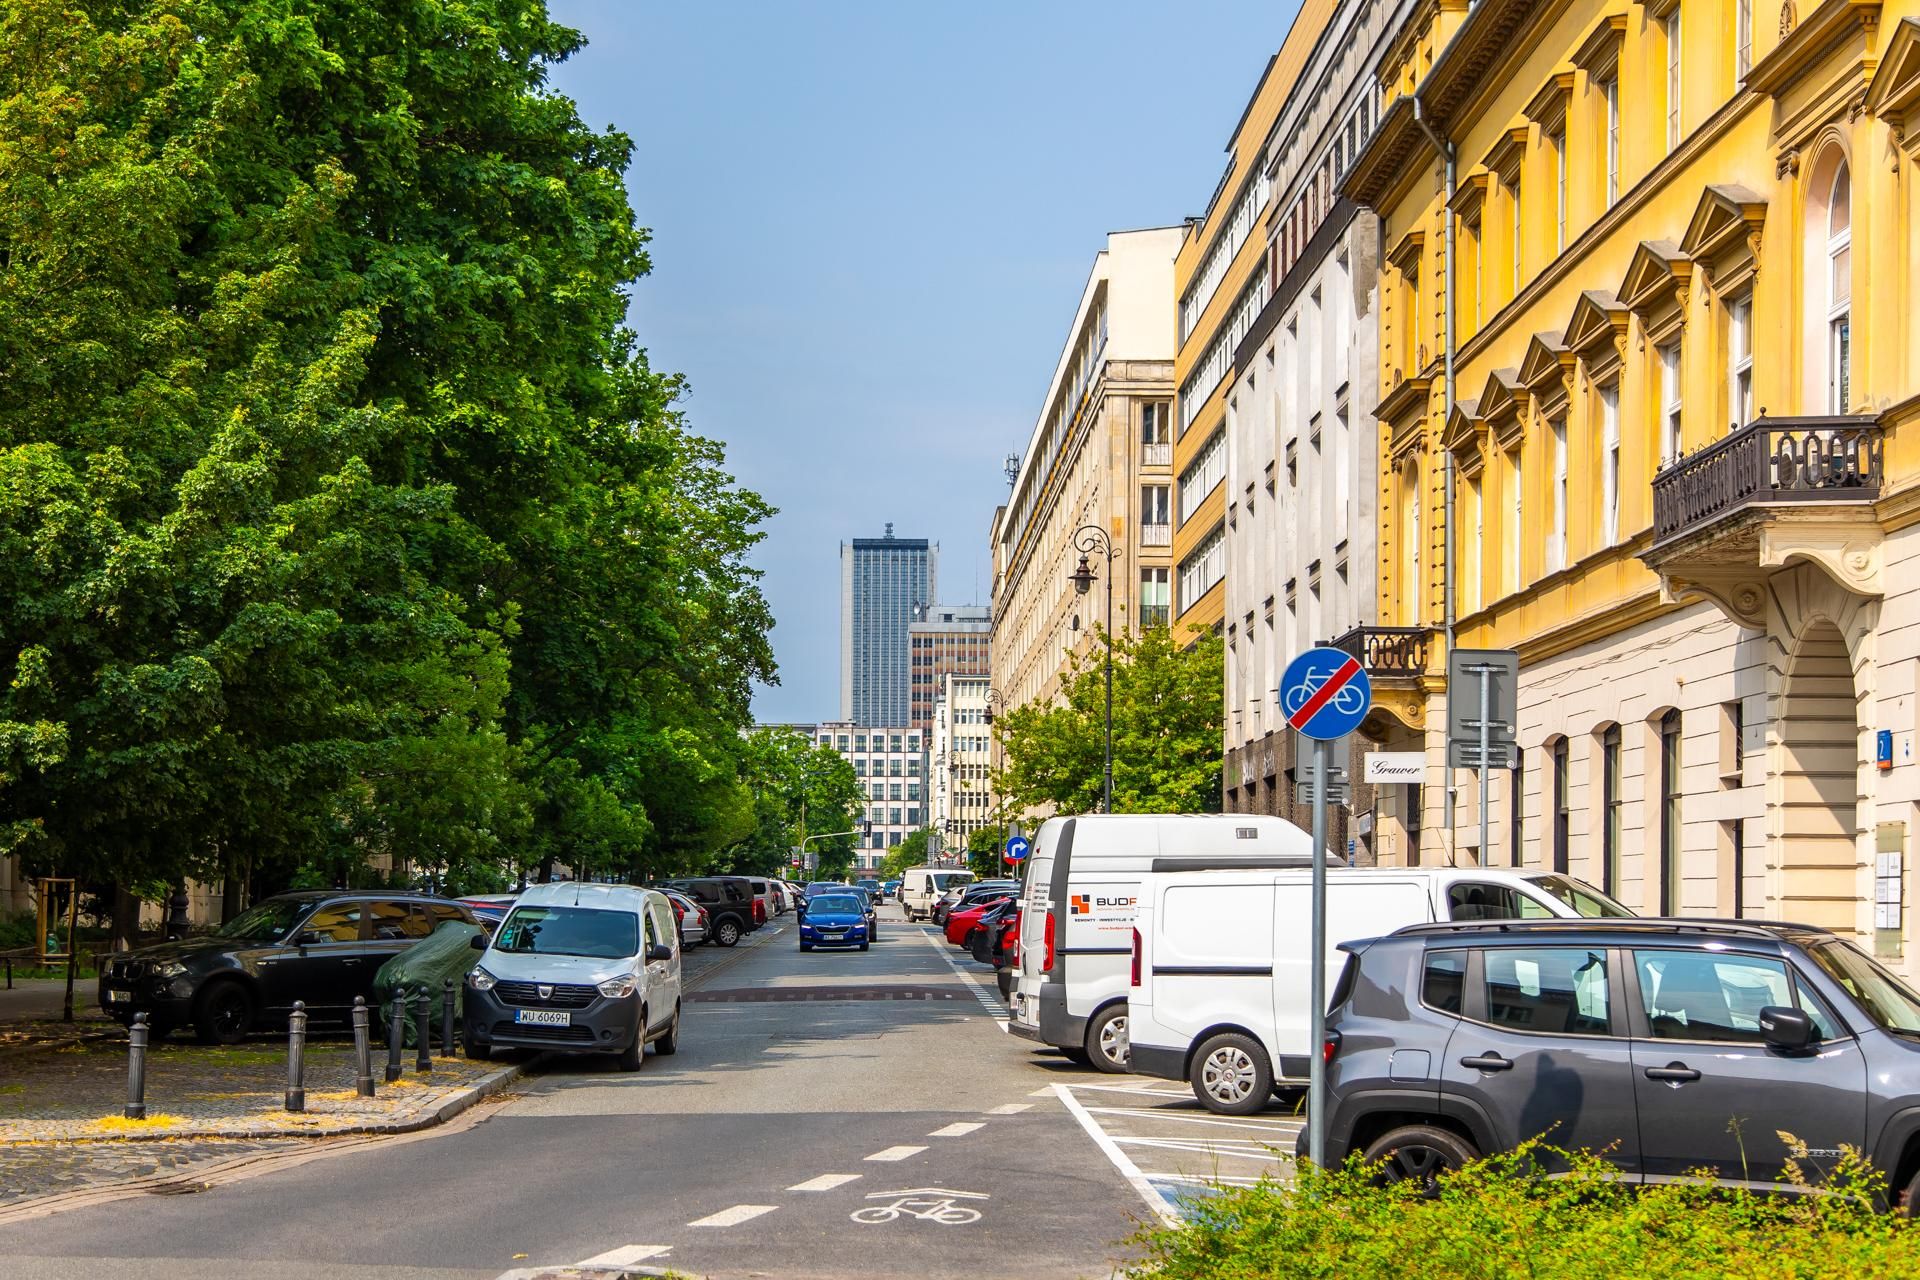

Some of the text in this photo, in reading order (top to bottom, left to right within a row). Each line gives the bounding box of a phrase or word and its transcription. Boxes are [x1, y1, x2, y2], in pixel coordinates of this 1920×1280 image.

[1879, 740, 1884, 759] 2
[1371, 760, 1421, 775] Grawer
[522, 1011, 568, 1023] WU 6069H
